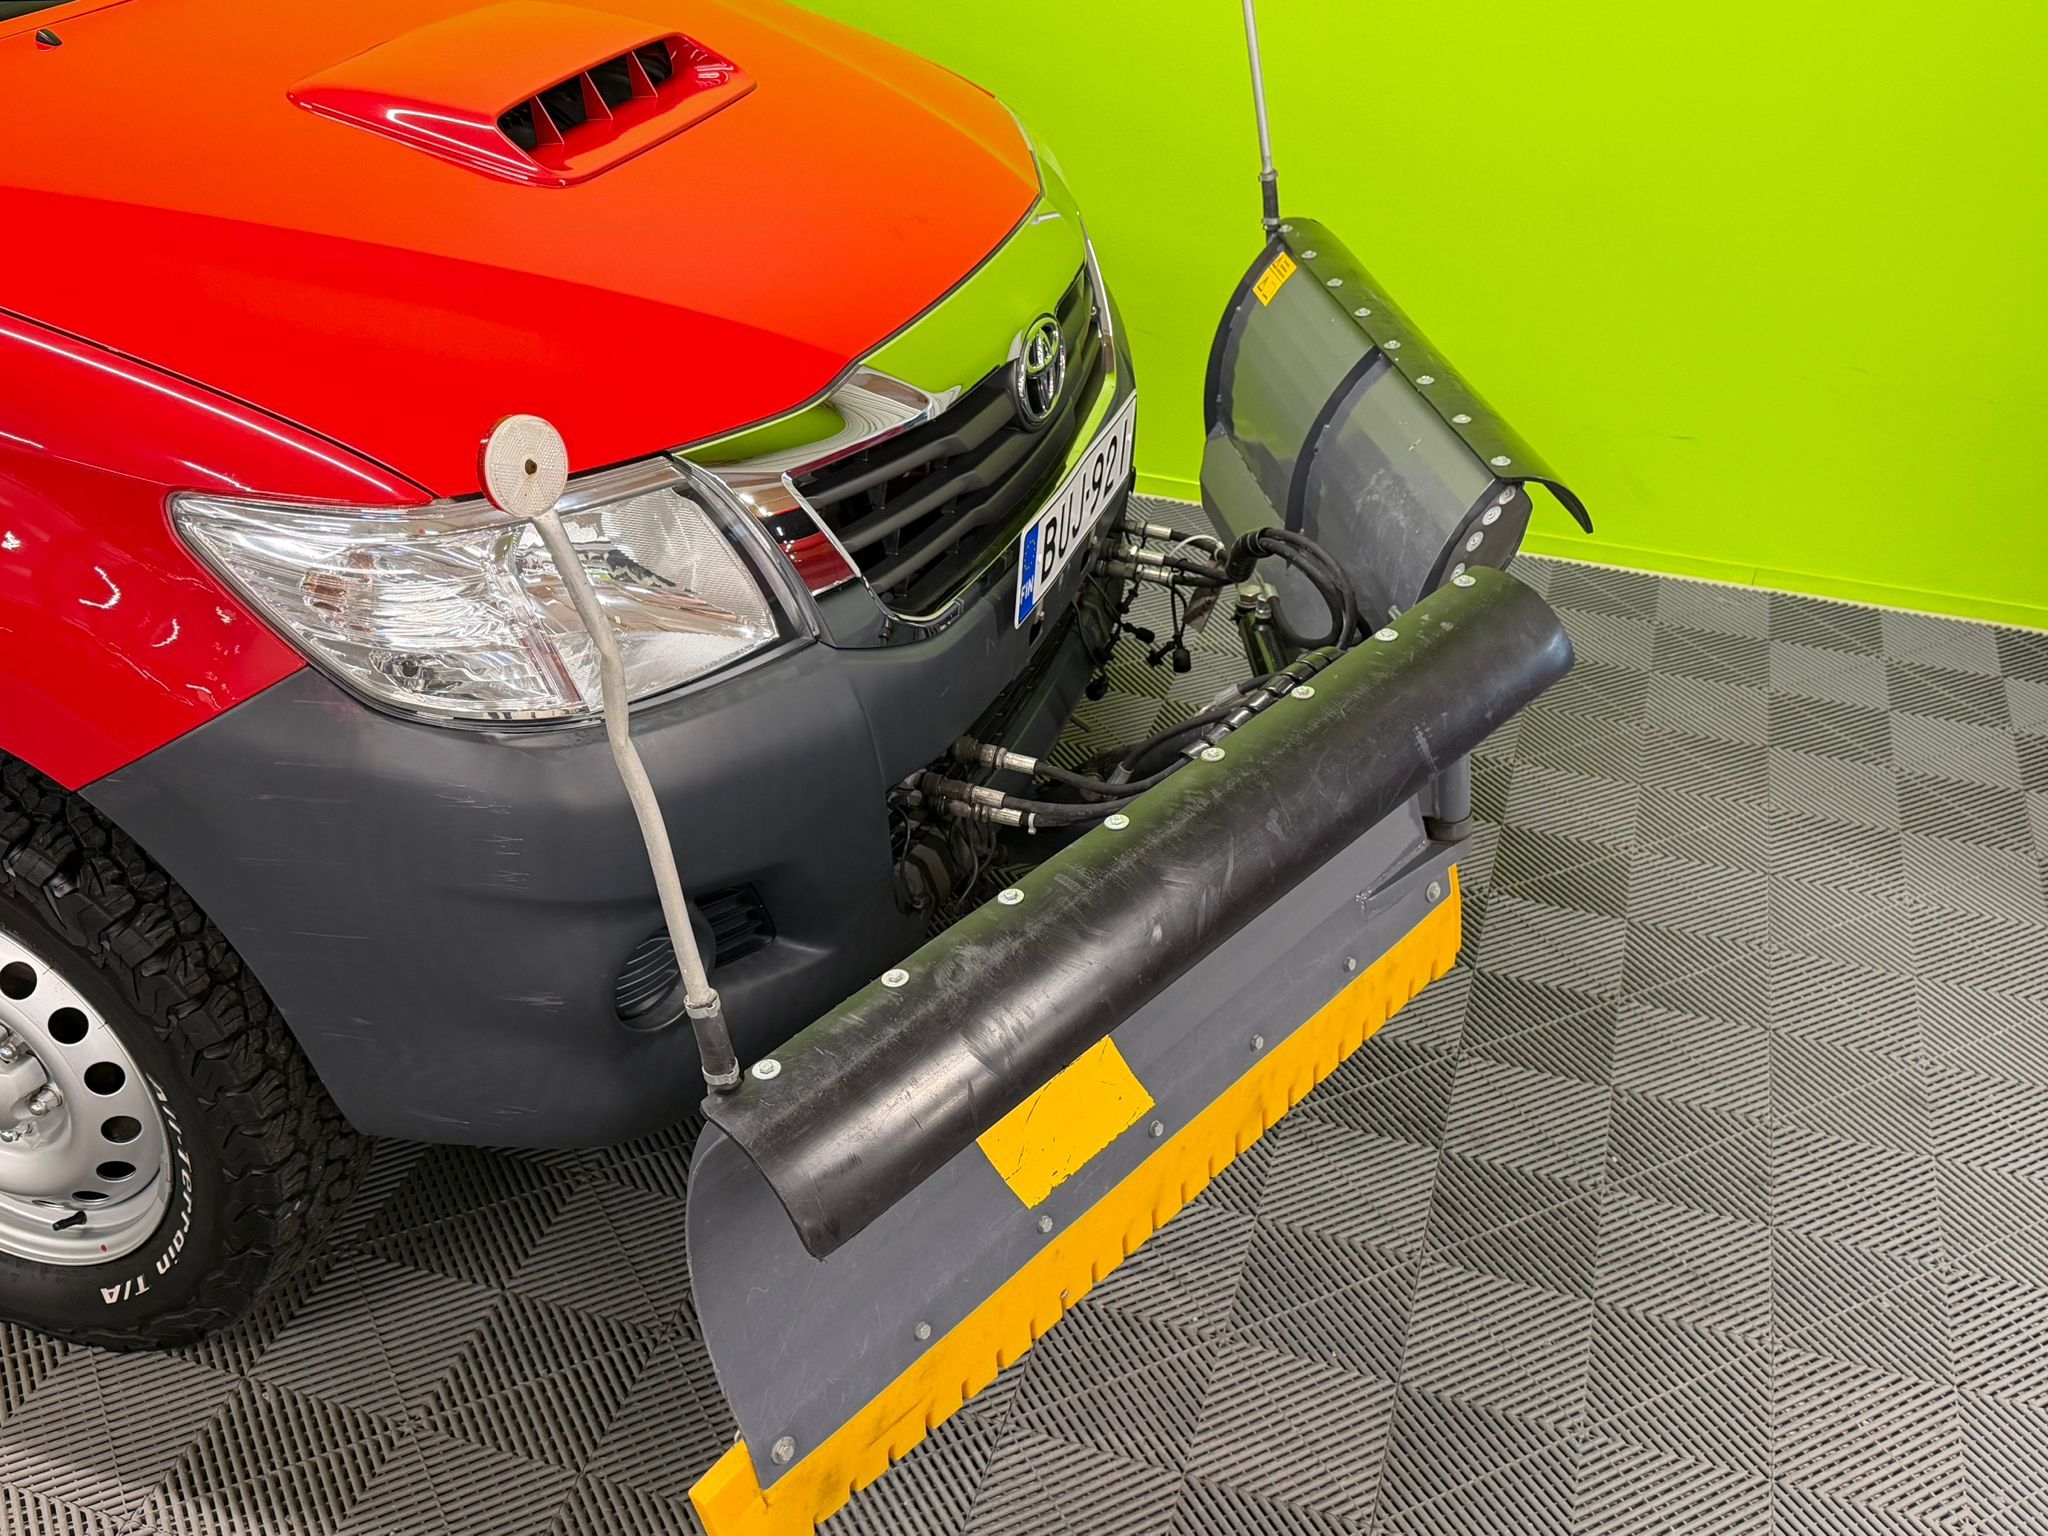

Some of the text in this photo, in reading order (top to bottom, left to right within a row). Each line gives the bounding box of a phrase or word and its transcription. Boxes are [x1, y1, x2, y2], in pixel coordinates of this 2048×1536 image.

[1041, 418, 1129, 585] BUJ-921
[1020, 575, 1034, 605] FIN
[100, 1274, 150, 1304] T/A
